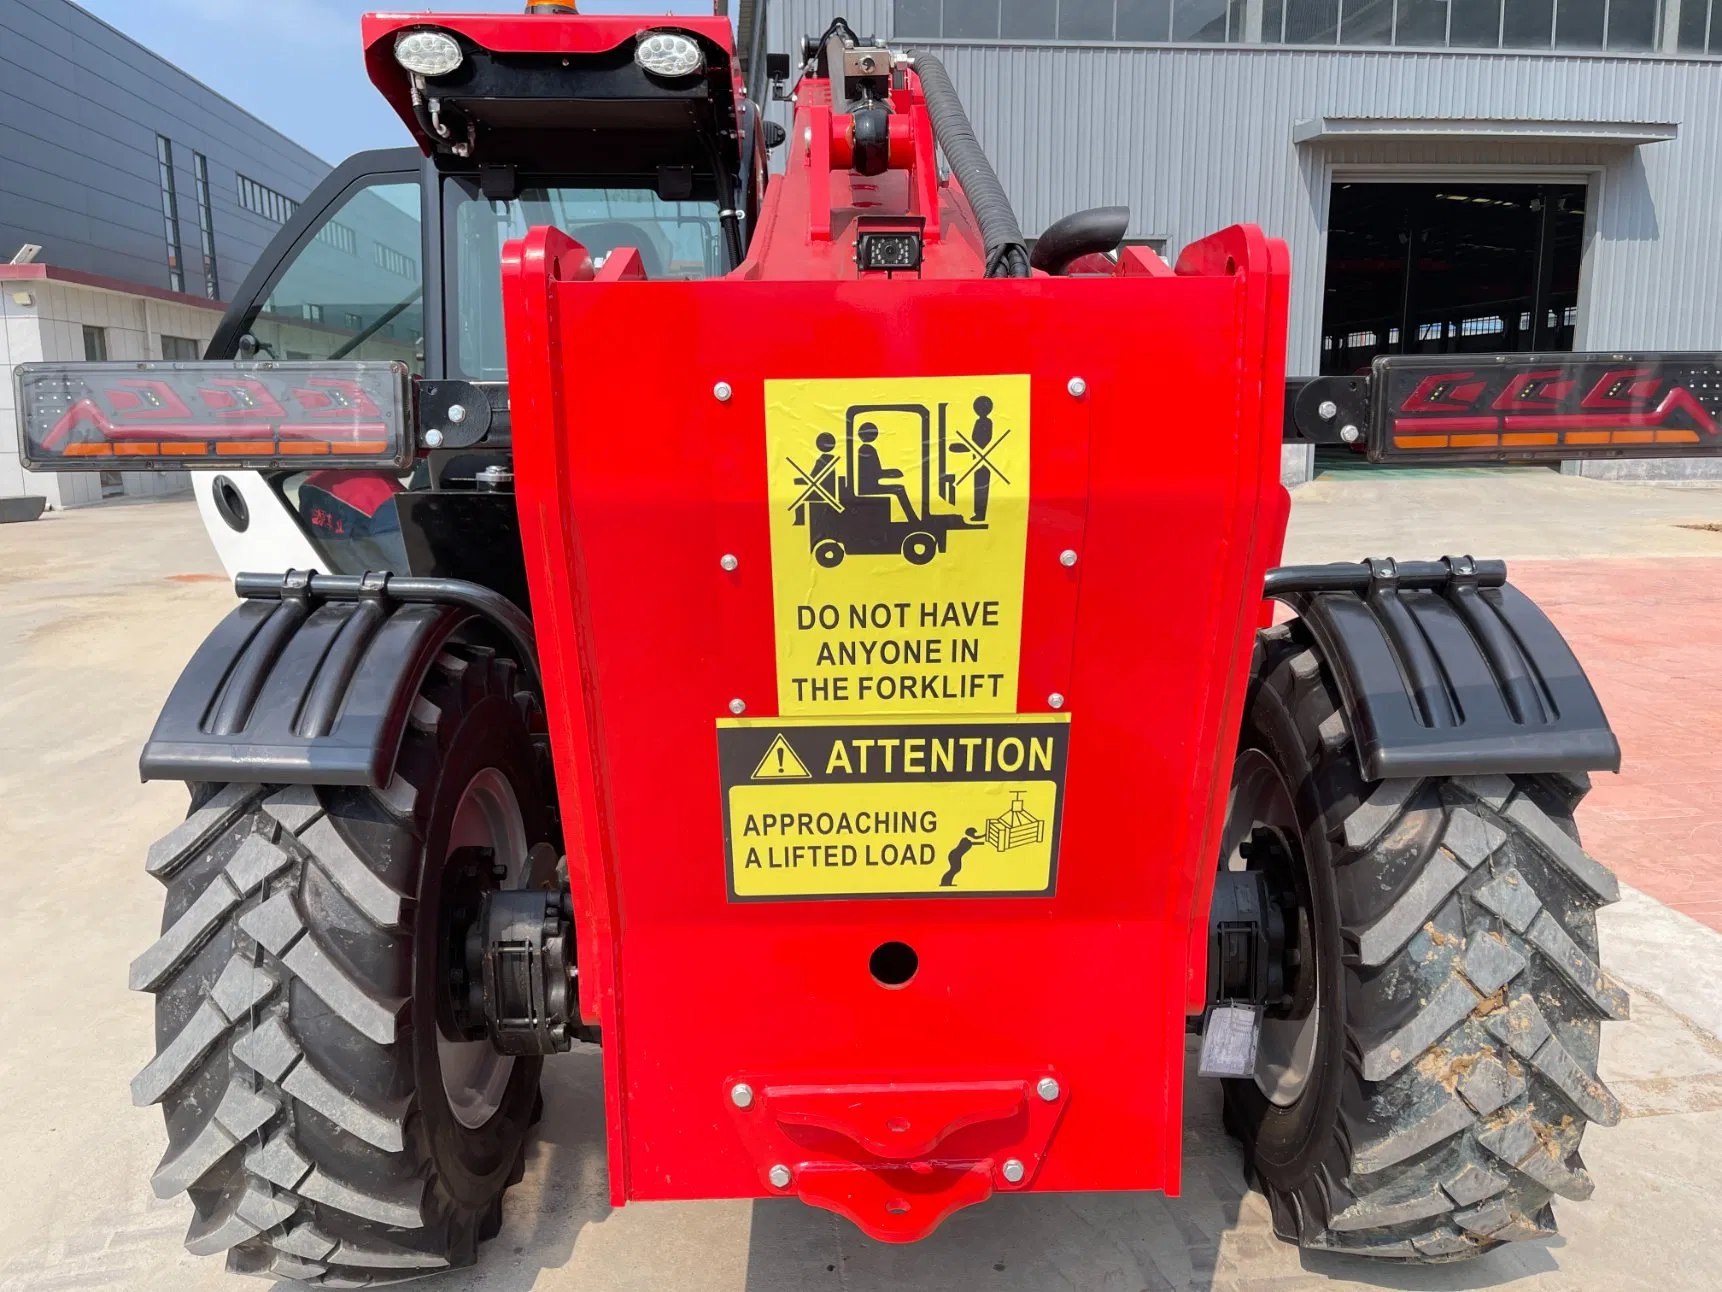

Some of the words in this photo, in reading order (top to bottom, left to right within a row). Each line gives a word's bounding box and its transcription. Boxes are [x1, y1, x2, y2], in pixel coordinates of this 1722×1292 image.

[798, 605, 839, 630] DO
[850, 603, 910, 628] NOT
[921, 601, 999, 627] HAVE
[817, 640, 941, 665] ANYONE
[952, 639, 978, 662] IN
[792, 678, 848, 701] THE
[859, 674, 1004, 700] FORKLIFT
[826, 737, 1053, 773] ATTENTION
[744, 811, 936, 836] APPROACHING
[745, 848, 761, 868] A
[769, 845, 857, 867] LIFTED
[866, 844, 935, 865] LOAD
